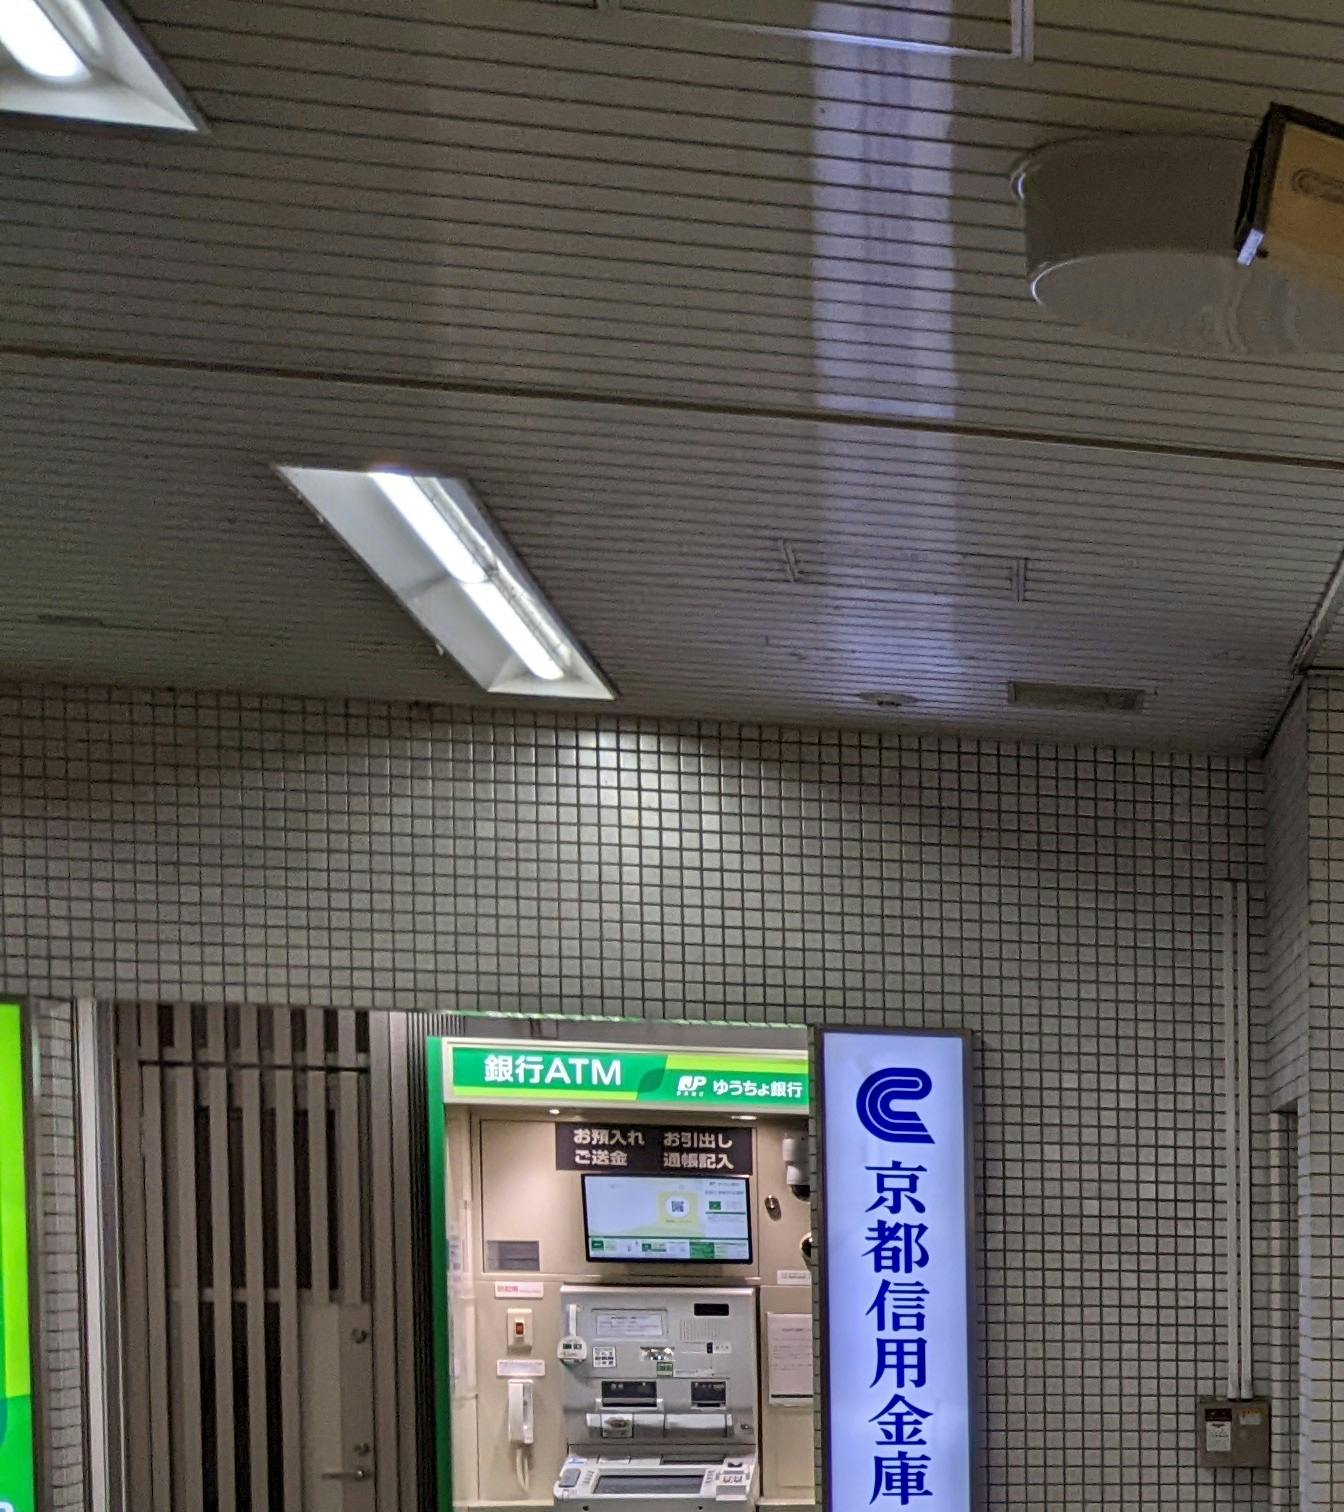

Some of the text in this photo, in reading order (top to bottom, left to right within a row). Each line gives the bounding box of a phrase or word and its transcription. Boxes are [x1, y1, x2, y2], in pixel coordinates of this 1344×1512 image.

[484, 1054, 622, 1086] 銀行ATM
[713, 1079, 803, 1098] ゆうちょ銀行
[573, 1128, 733, 1149] お預入れ お引出し
[575, 1149, 735, 1169] ご送金 通帳記入
[861, 1160, 934, 1506] 京都信用金庫
